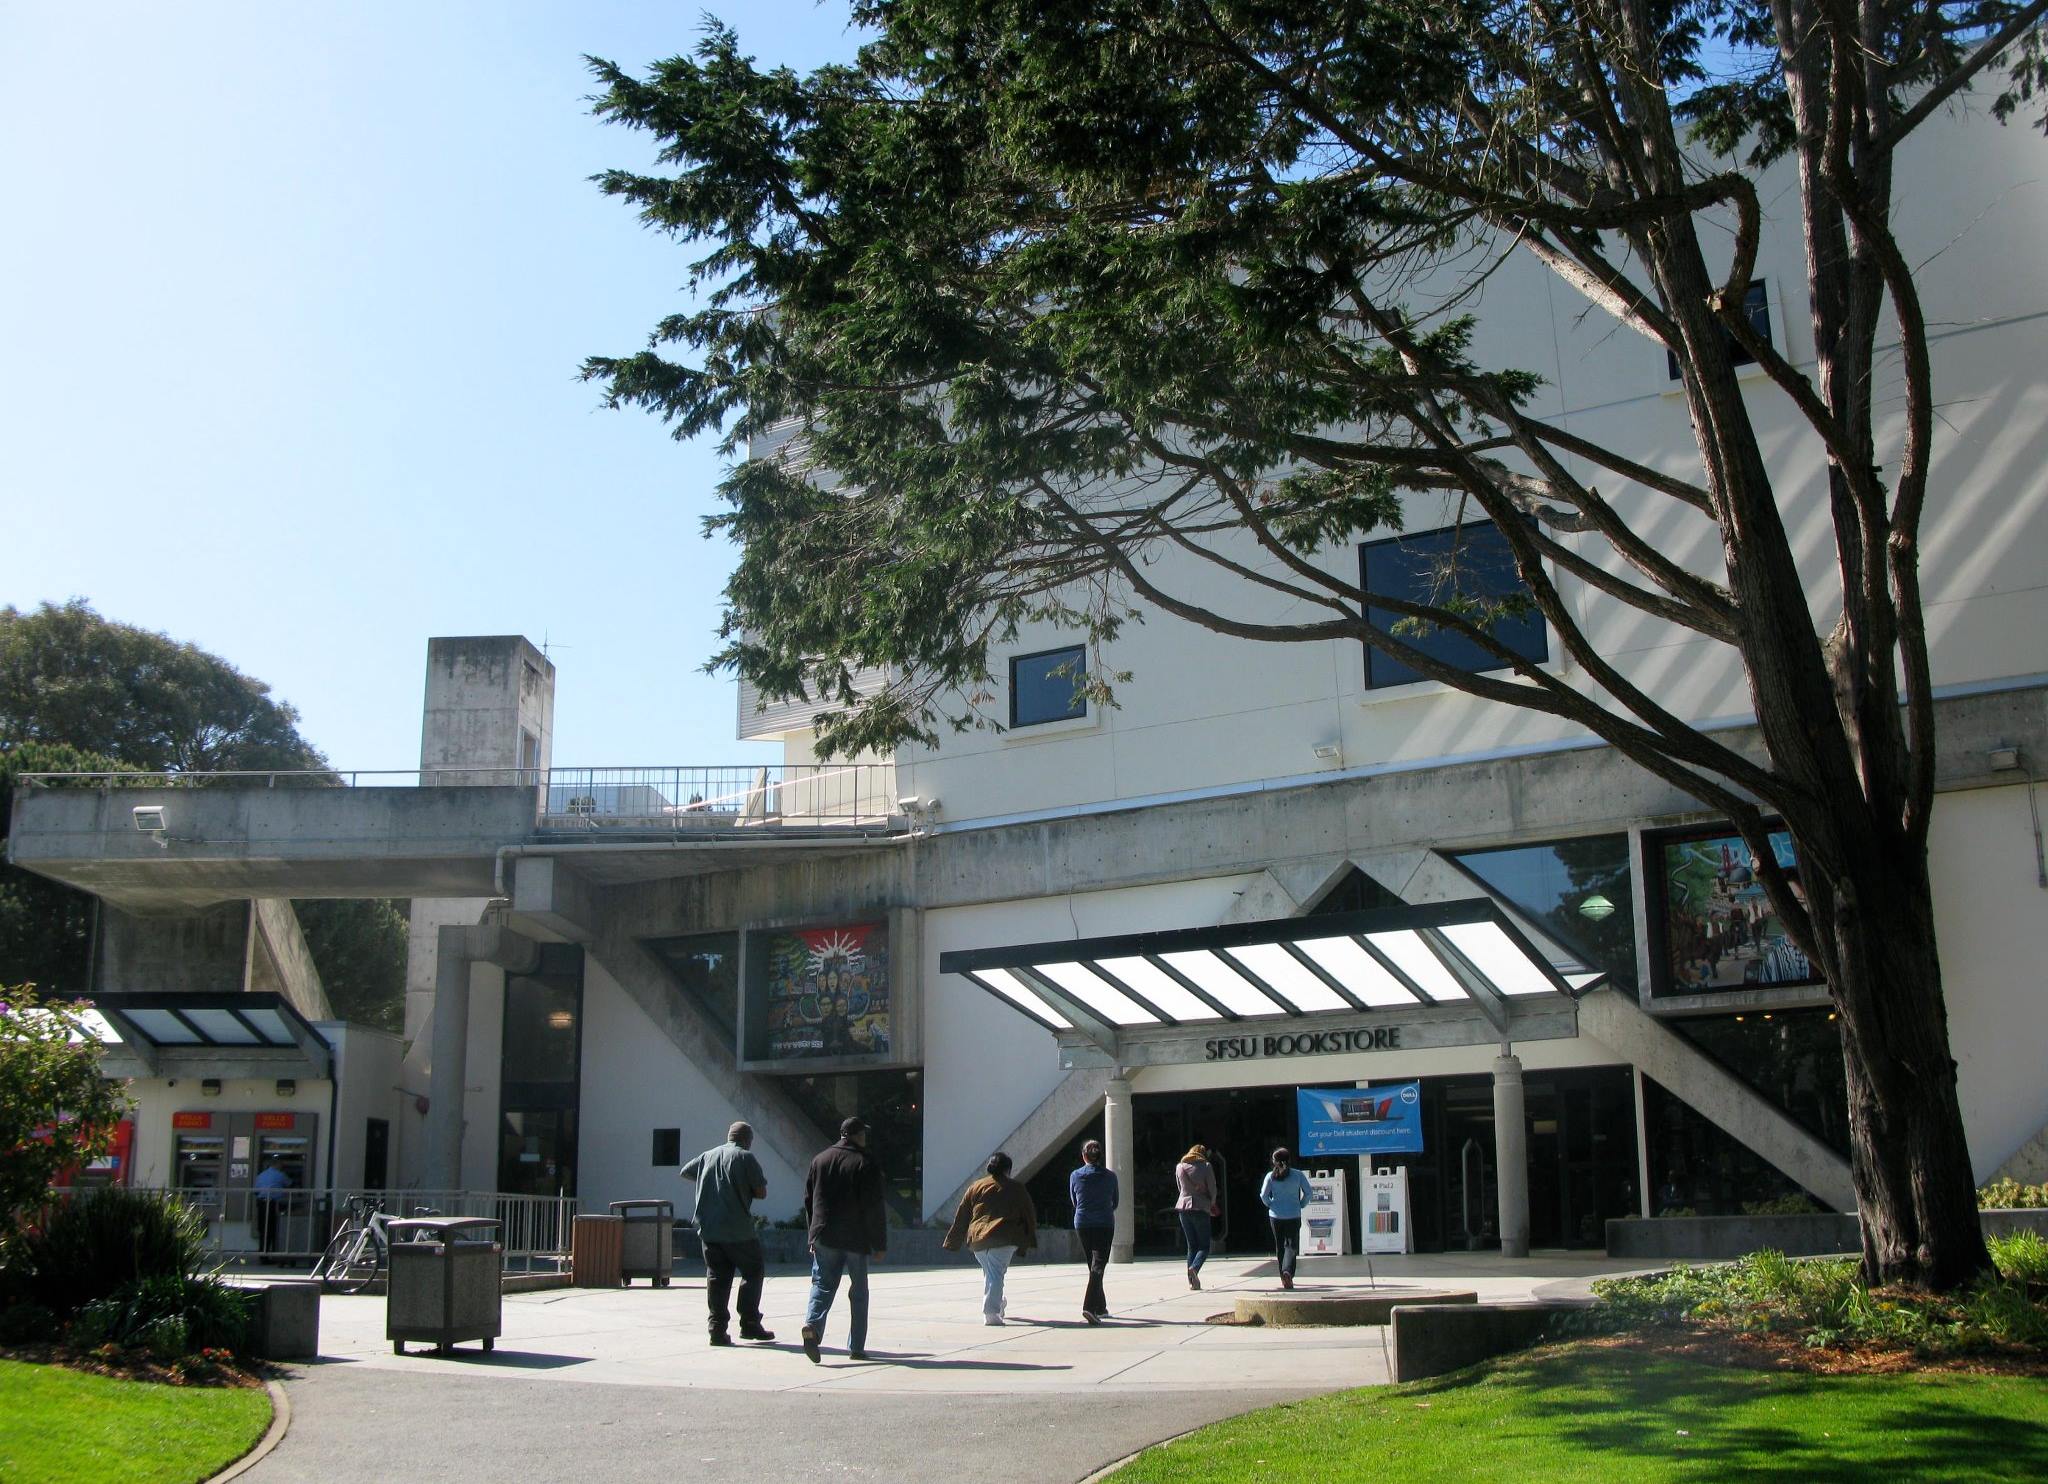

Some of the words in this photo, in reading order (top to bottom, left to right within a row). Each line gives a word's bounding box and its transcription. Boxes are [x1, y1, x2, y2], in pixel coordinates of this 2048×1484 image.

[1205, 1038, 1257, 1060] SFSU
[1263, 1027, 1401, 1056] BOOKSTORE
[1369, 1128, 1396, 1136] discount
